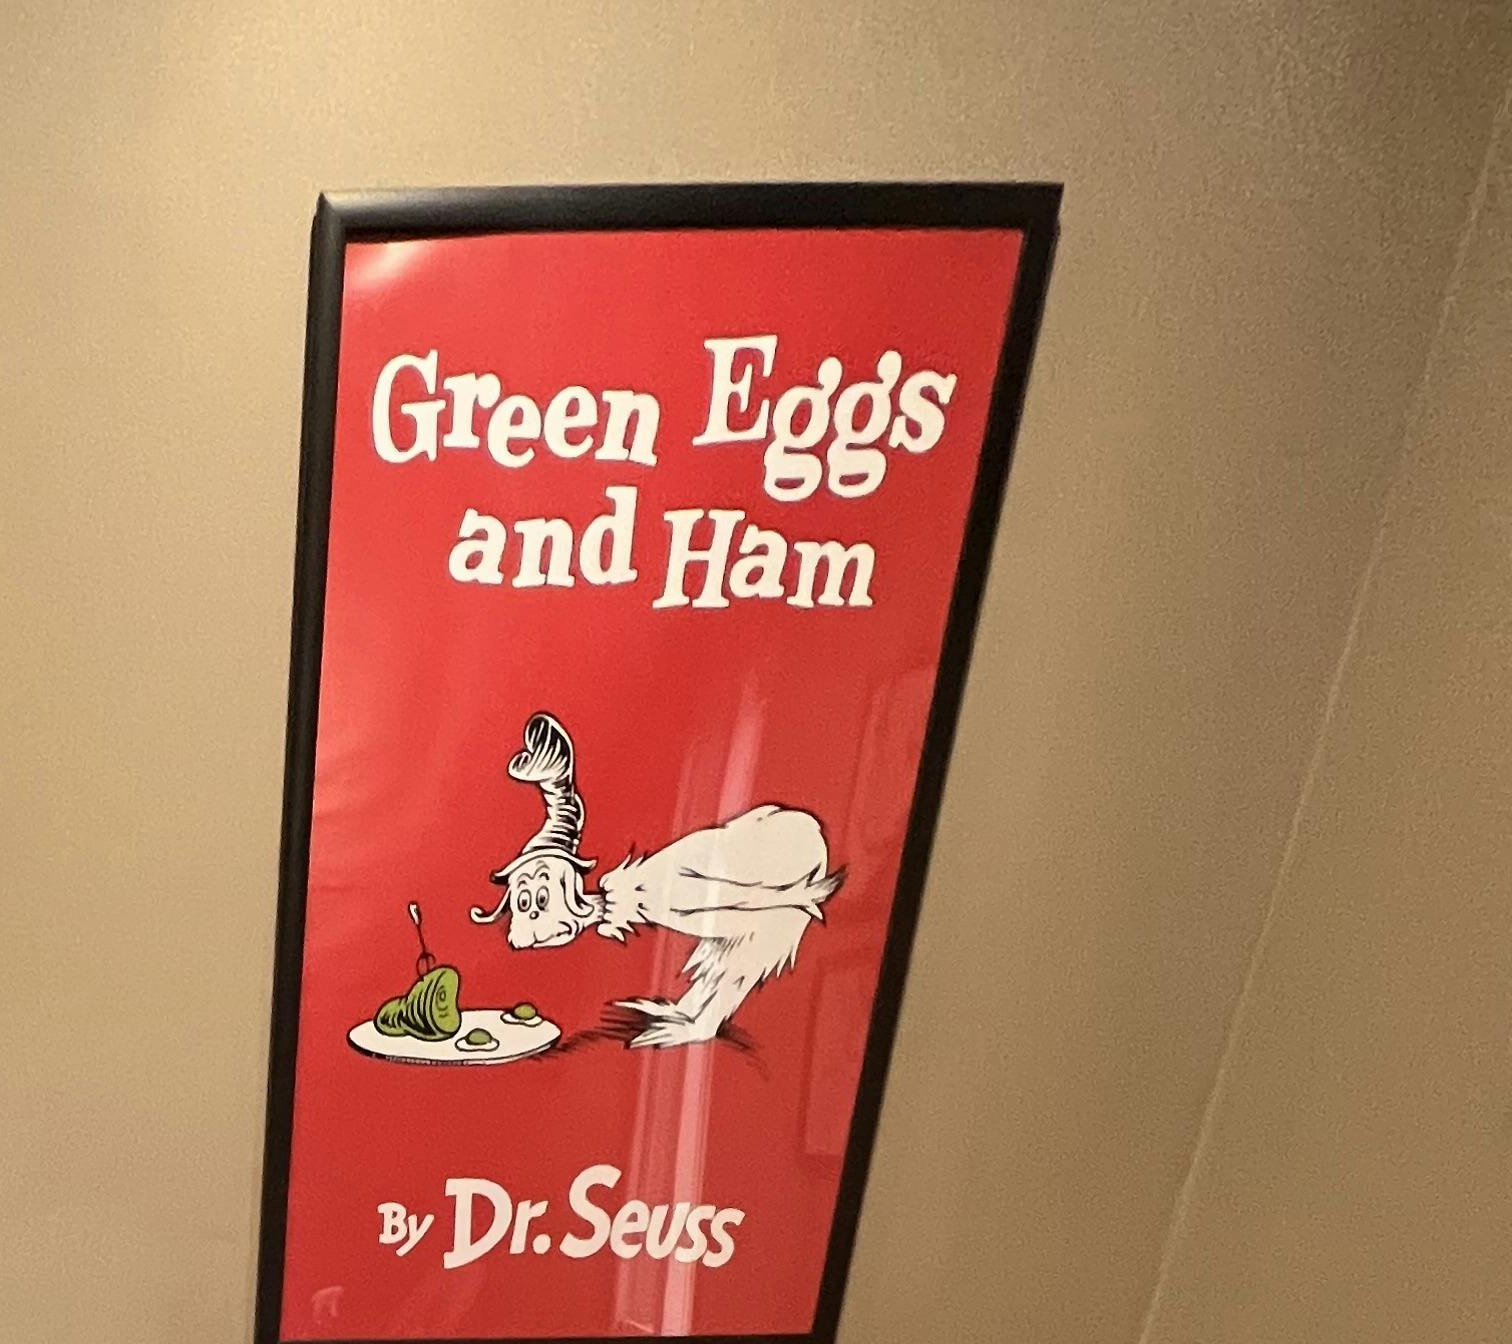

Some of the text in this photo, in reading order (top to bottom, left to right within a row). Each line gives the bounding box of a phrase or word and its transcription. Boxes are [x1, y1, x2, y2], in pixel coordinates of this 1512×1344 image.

[371, 334, 958, 502] Green Eggs
[447, 485, 875, 610] and Ham
[376, 1163, 747, 1270] By Dr. Seuss
